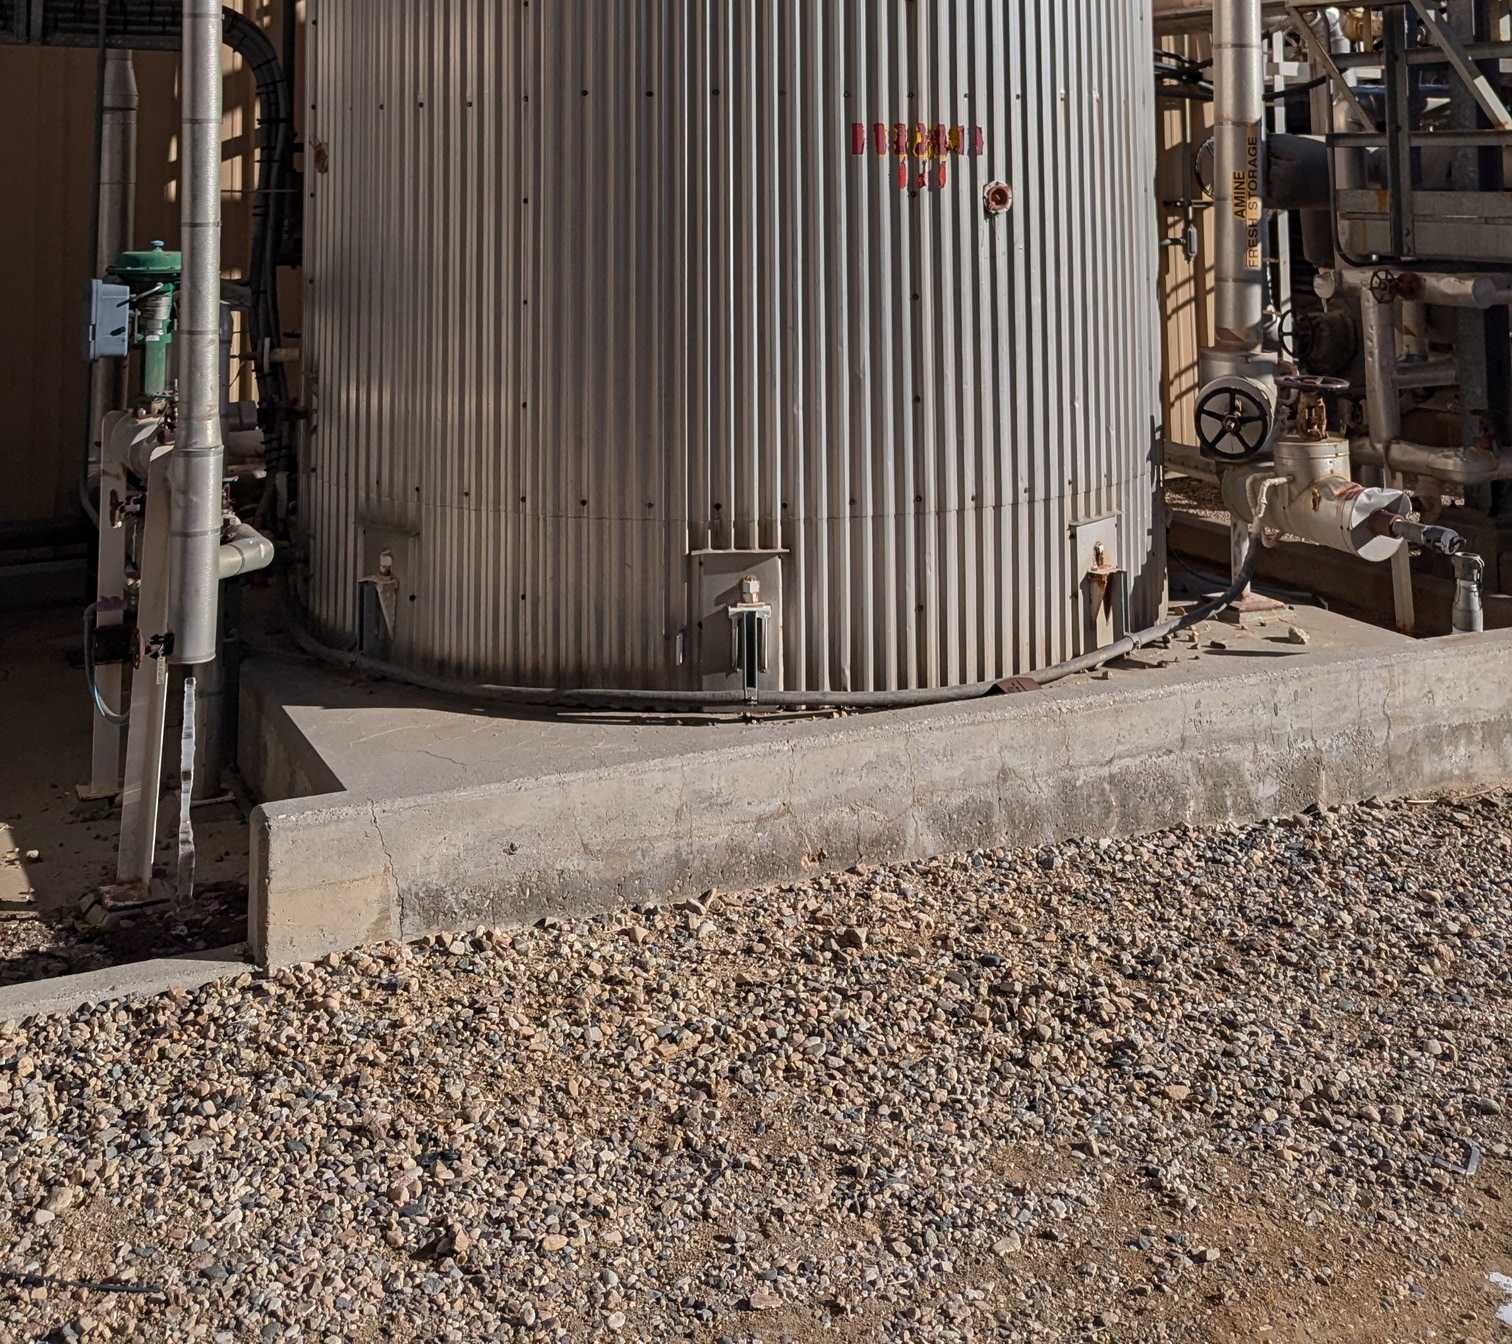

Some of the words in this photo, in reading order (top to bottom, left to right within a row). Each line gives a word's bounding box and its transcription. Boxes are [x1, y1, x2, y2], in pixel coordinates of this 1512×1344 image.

[1233, 171, 1246, 219] AMINE
[1248, 135, 1258, 210] STORAGE
[1248, 219, 1258, 268] FRESH
